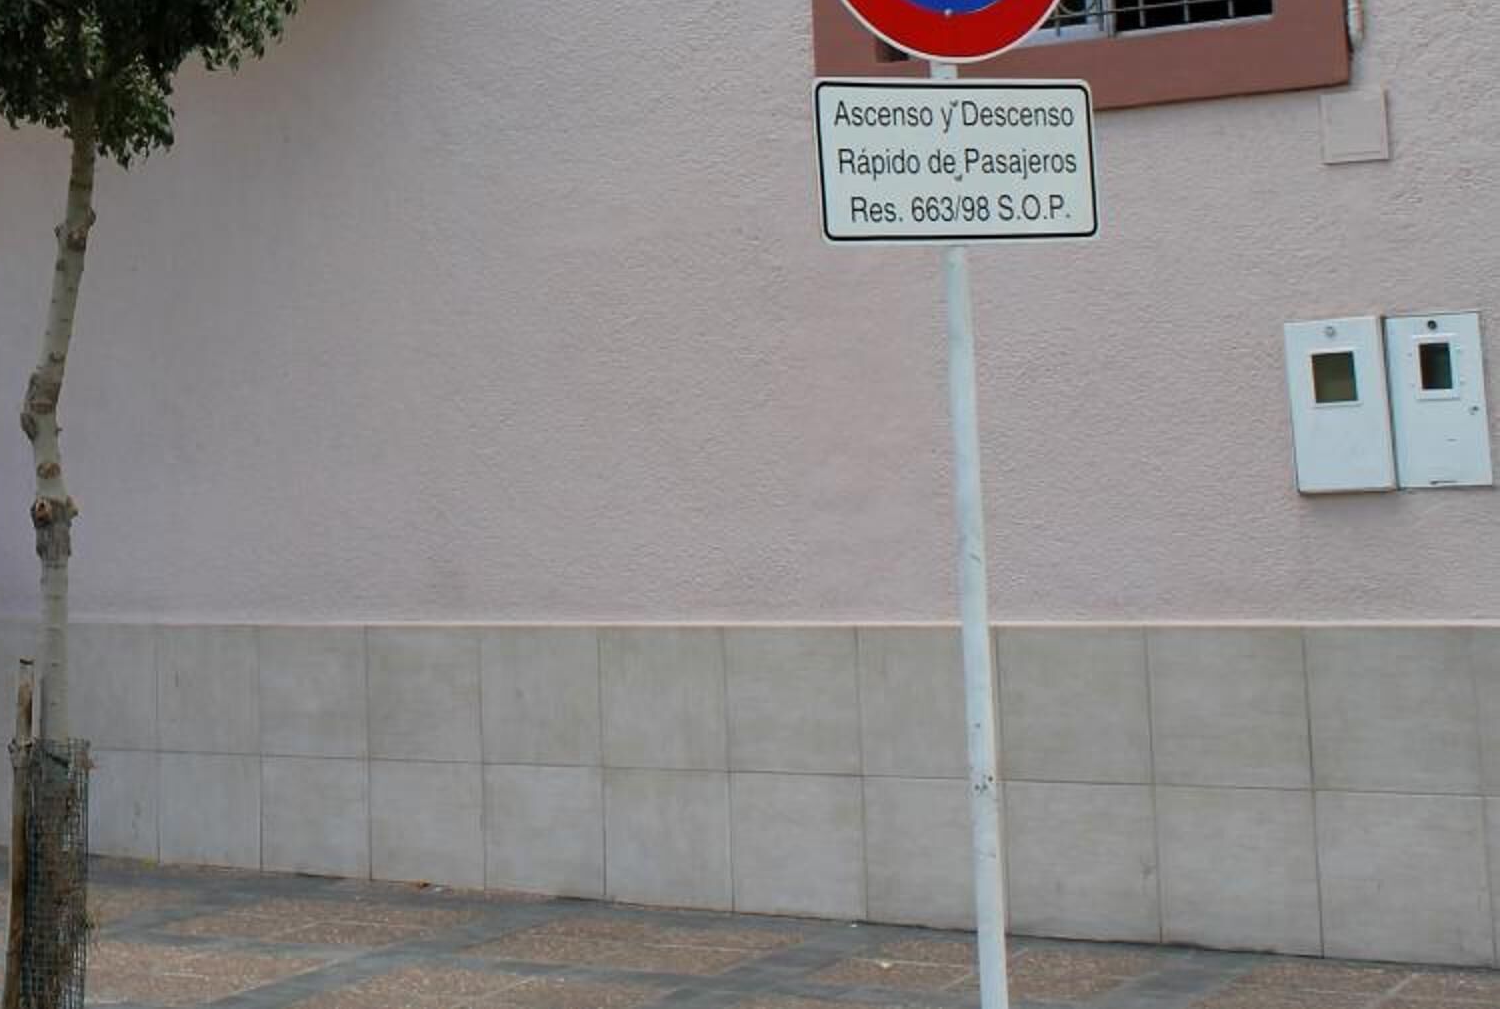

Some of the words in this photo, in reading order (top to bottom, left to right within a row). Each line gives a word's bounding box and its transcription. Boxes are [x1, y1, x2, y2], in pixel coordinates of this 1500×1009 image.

[833, 99, 933, 127] Ascenso
[941, 106, 954, 133] y
[961, 100, 1075, 127] Descenso
[837, 147, 921, 181] Rápido
[928, 149, 956, 174] de
[964, 148, 1077, 180] Pasajeros
[851, 196, 903, 223] Res.
[911, 195, 990, 223] 663/98
[997, 194, 1071, 221] S.O.P.
